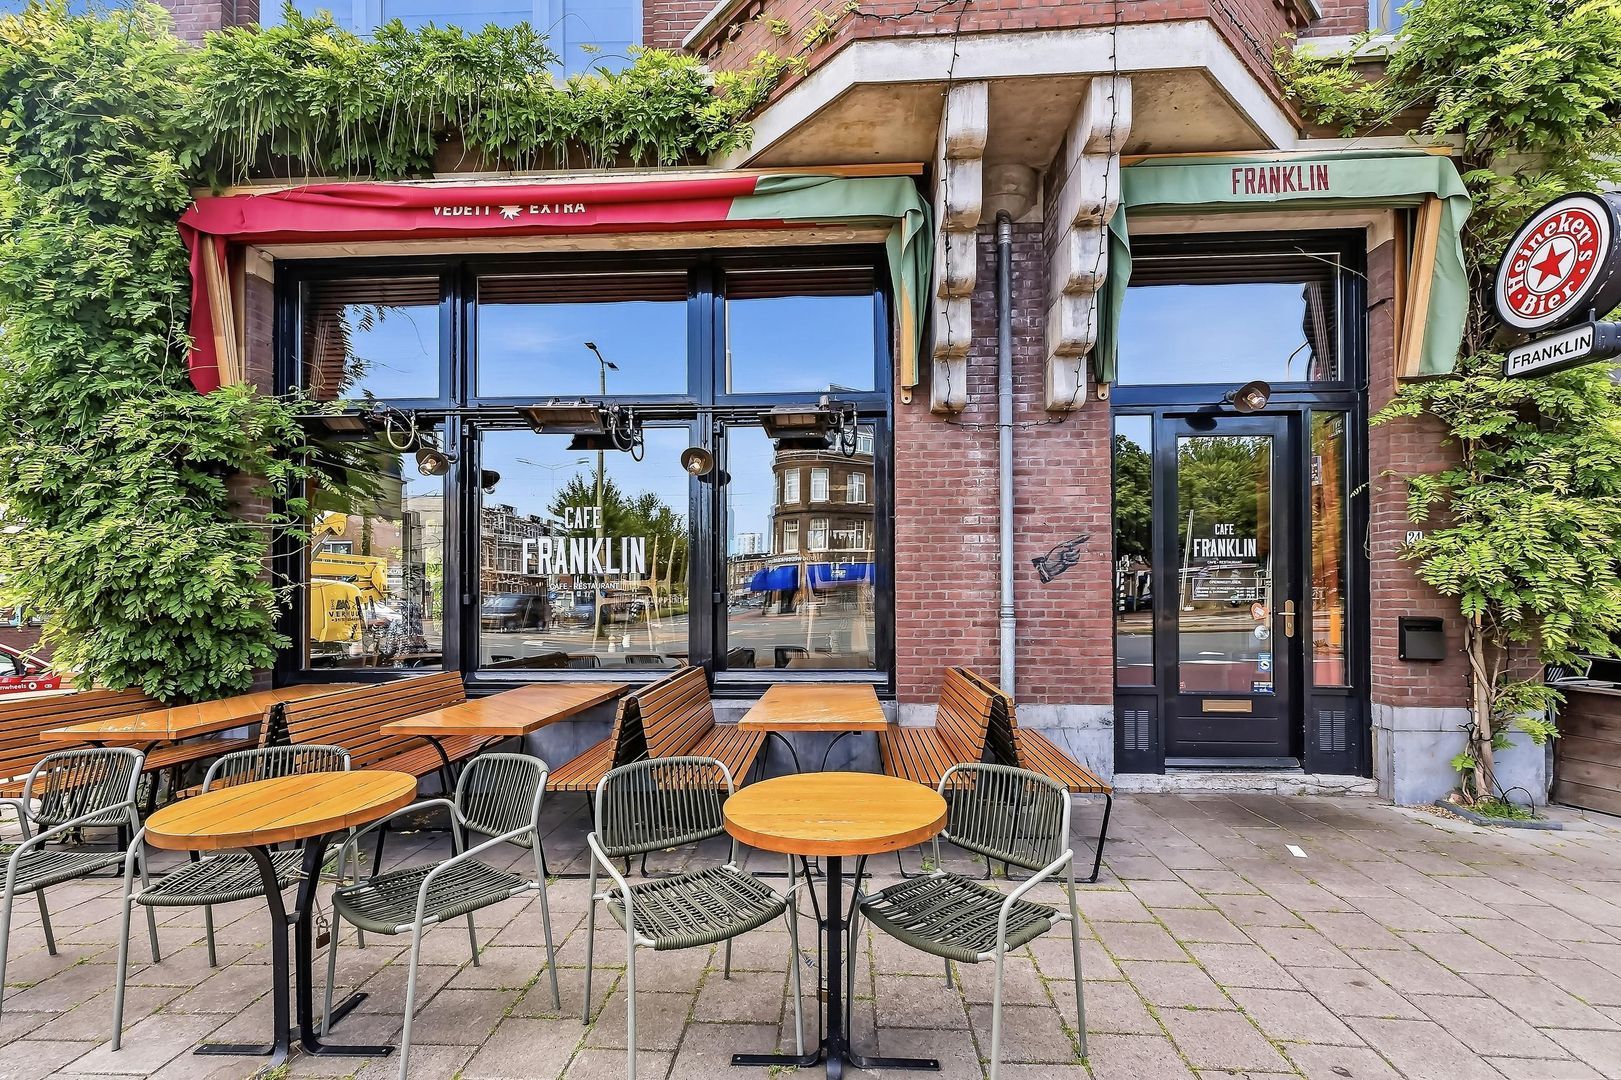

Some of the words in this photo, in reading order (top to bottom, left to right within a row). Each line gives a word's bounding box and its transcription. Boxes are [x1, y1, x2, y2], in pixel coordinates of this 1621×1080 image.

[1231, 164, 1329, 195] FRANKLIN
[1508, 213, 1593, 296] Heineken's
[1518, 279, 1576, 315] Bier
[1512, 333, 1592, 370] FRANKLIN
[565, 506, 602, 529] CAFE
[1215, 524, 1234, 535] CAFE
[522, 536, 646, 575] FRANKLIN
[1193, 538, 1256, 557] FRANKLIN
[549, 582, 568, 590] CAFE
[573, 582, 620, 590] RESTAURANT
